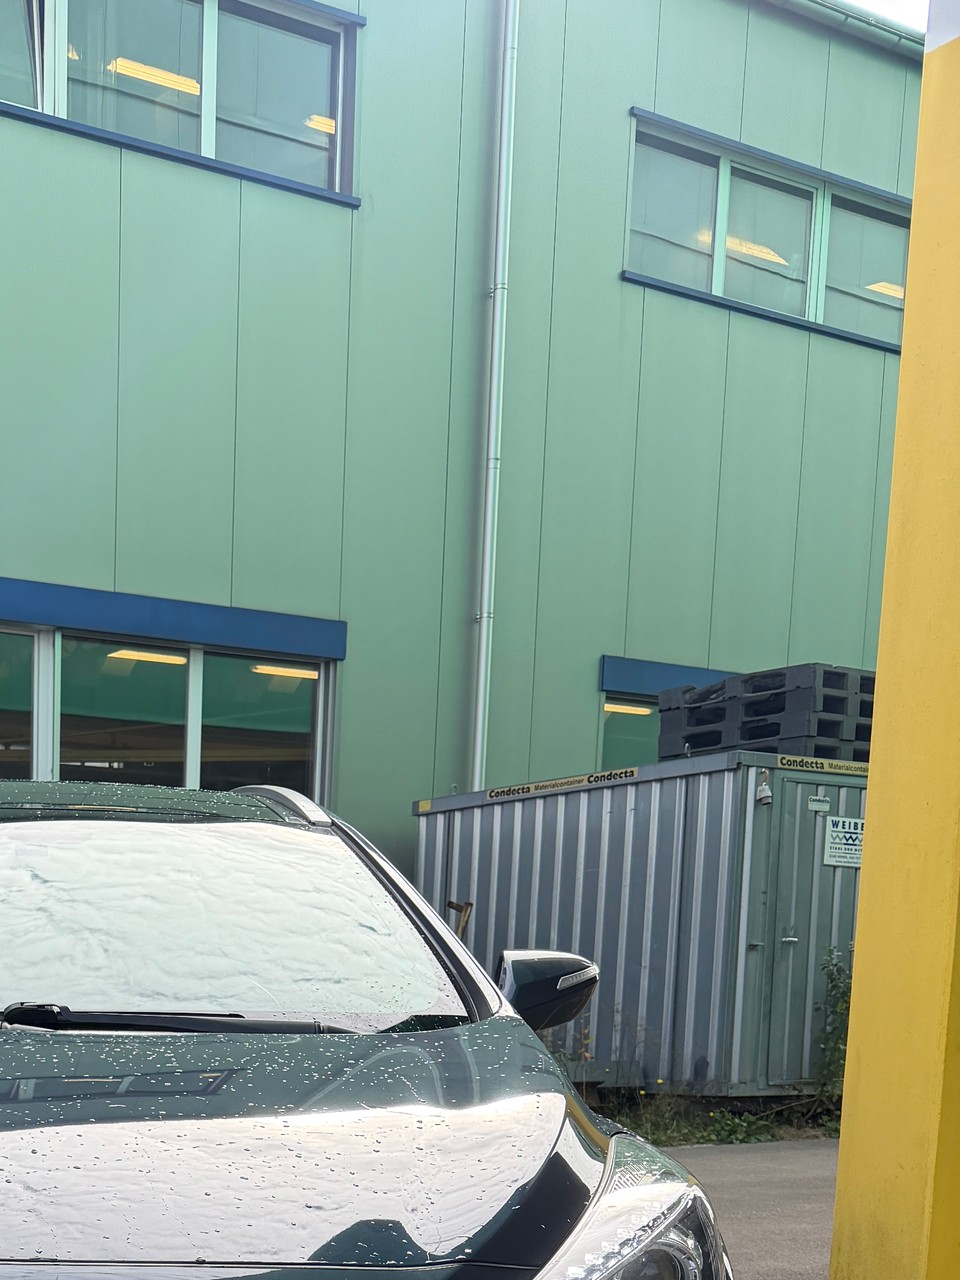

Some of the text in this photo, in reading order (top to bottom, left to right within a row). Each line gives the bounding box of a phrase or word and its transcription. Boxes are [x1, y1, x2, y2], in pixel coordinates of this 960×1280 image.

[780, 756, 868, 773] Condecta Materialcontai
[489, 769, 634, 799] Condecta Materialcontainer Condecta
[831, 819, 864, 831] WEIBE
